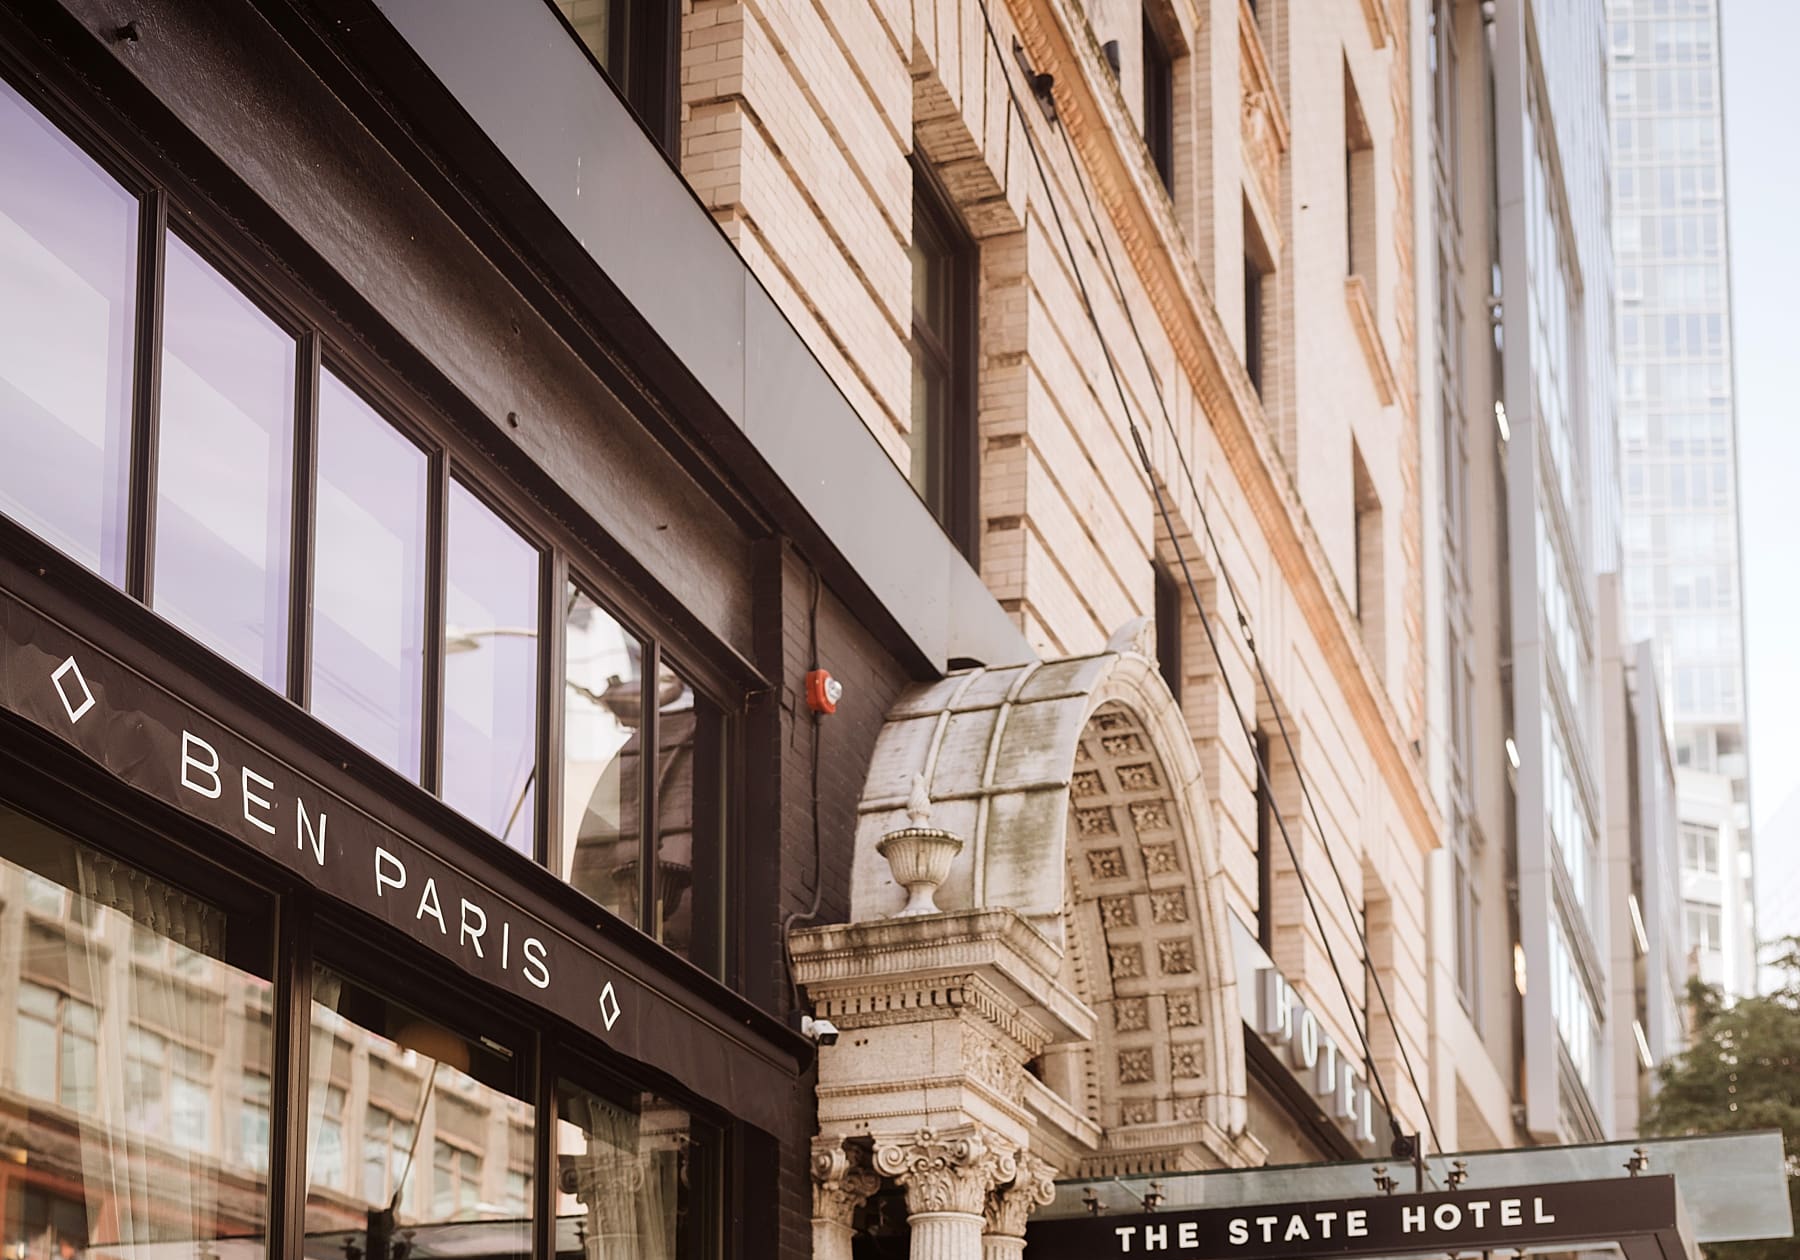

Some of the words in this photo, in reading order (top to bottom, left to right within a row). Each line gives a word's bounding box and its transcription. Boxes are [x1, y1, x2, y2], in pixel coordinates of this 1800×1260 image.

[181, 729, 328, 866] BEN
[375, 846, 551, 989] PARIS
[1275, 972, 1377, 1144] HOTEL
[1115, 1222, 1200, 1252] THE
[1229, 1210, 1369, 1246] STATE
[1402, 1197, 1556, 1234] HOTEL
